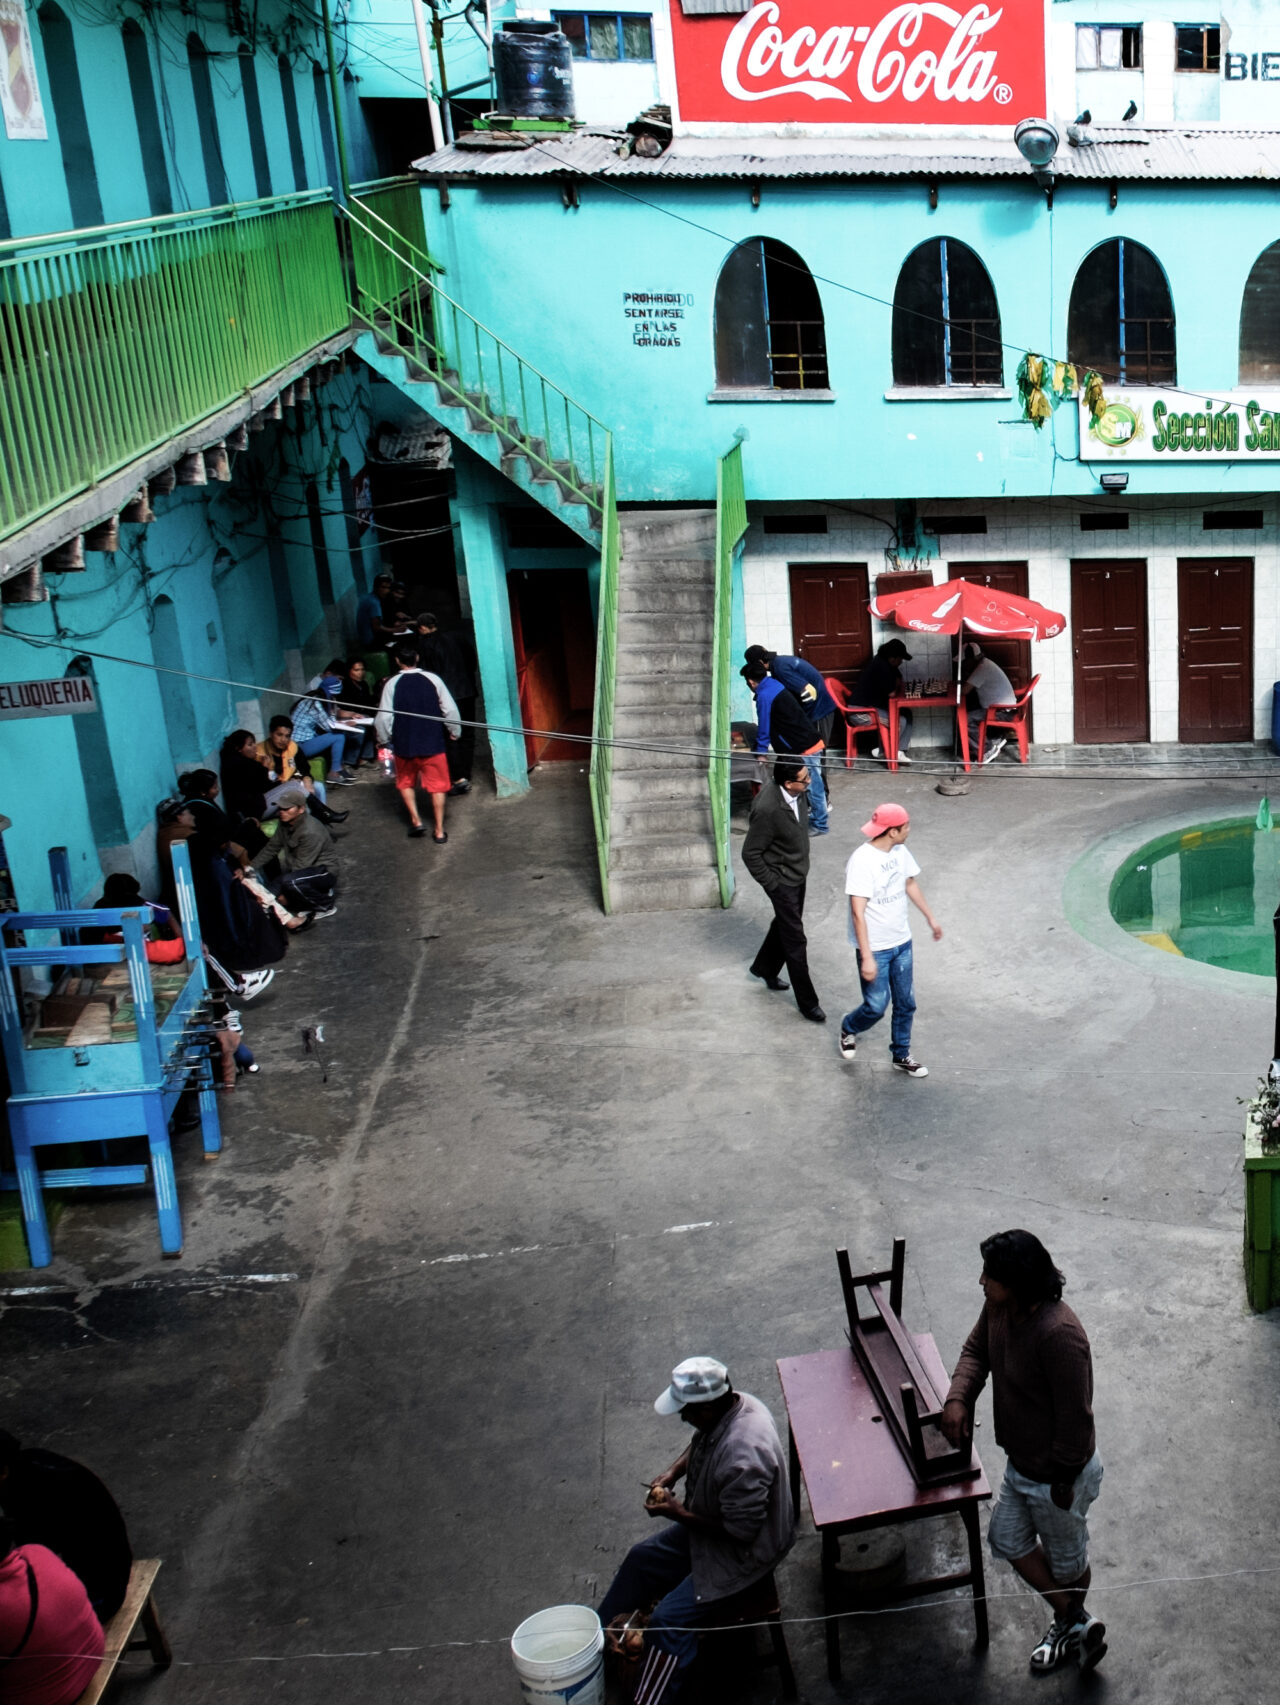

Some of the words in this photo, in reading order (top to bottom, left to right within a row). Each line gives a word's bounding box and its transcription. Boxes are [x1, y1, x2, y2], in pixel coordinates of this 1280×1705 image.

[721, 1, 1003, 103] Coca-Cola
[624, 308, 684, 319] SENTARSE
[655, 322, 677, 333] LAS
[1152, 399, 1239, 452] Sección
[0, 680, 92, 709] ELUQUERIA
